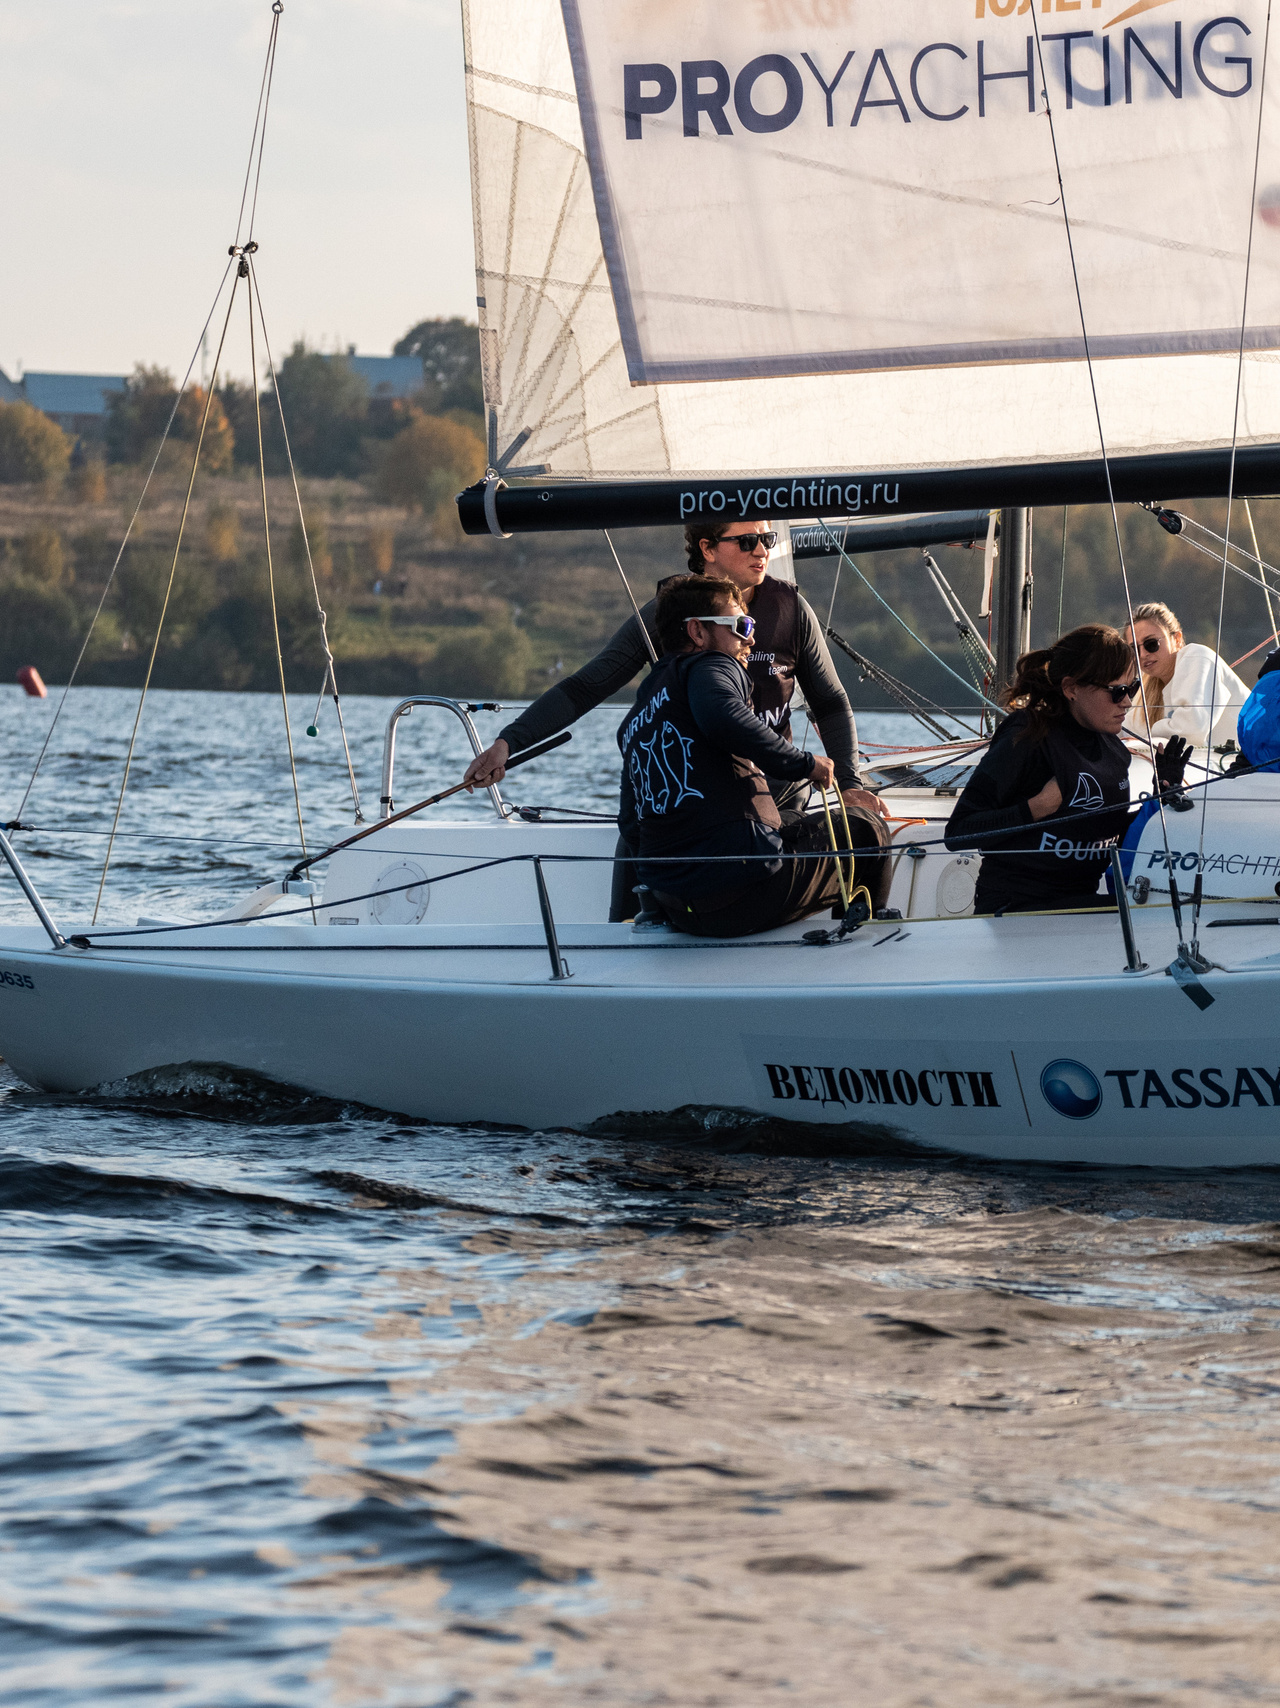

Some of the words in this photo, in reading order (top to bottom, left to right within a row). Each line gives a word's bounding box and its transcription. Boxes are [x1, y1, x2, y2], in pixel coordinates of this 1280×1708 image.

[624, 17, 1252, 140] PROYACHTING
[679, 479, 900, 519] pro-yachting.ru
[747, 651, 775, 663] ailing
[768, 665, 788, 676] team
[622, 687, 671, 754] OURTUNA
[763, 1063, 1002, 1111] ВЕДОМОСТИ
